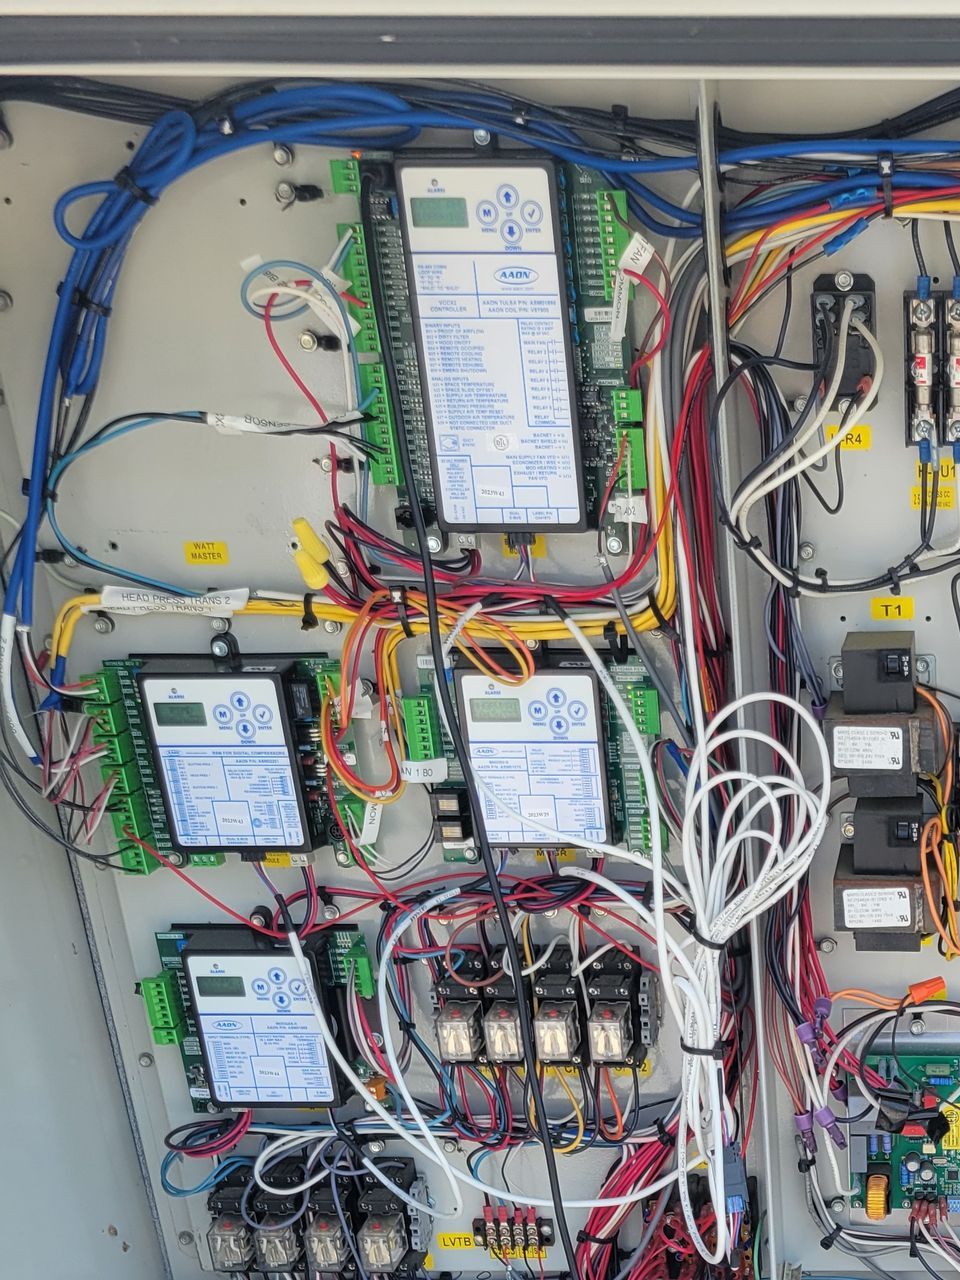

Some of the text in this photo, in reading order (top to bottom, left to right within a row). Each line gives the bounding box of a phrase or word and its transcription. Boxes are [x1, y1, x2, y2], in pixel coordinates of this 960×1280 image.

[500, 271, 531, 279] AAON
[831, 433, 863, 445] -R4
[191, 552, 222, 560] MASTER
[122, 593, 149, 602] HEAD
[152, 596, 186, 605] PRESS
[190, 597, 221, 605] TRANS
[881, 605, 902, 617] T1
[443, 1237, 472, 1247] LVTB
